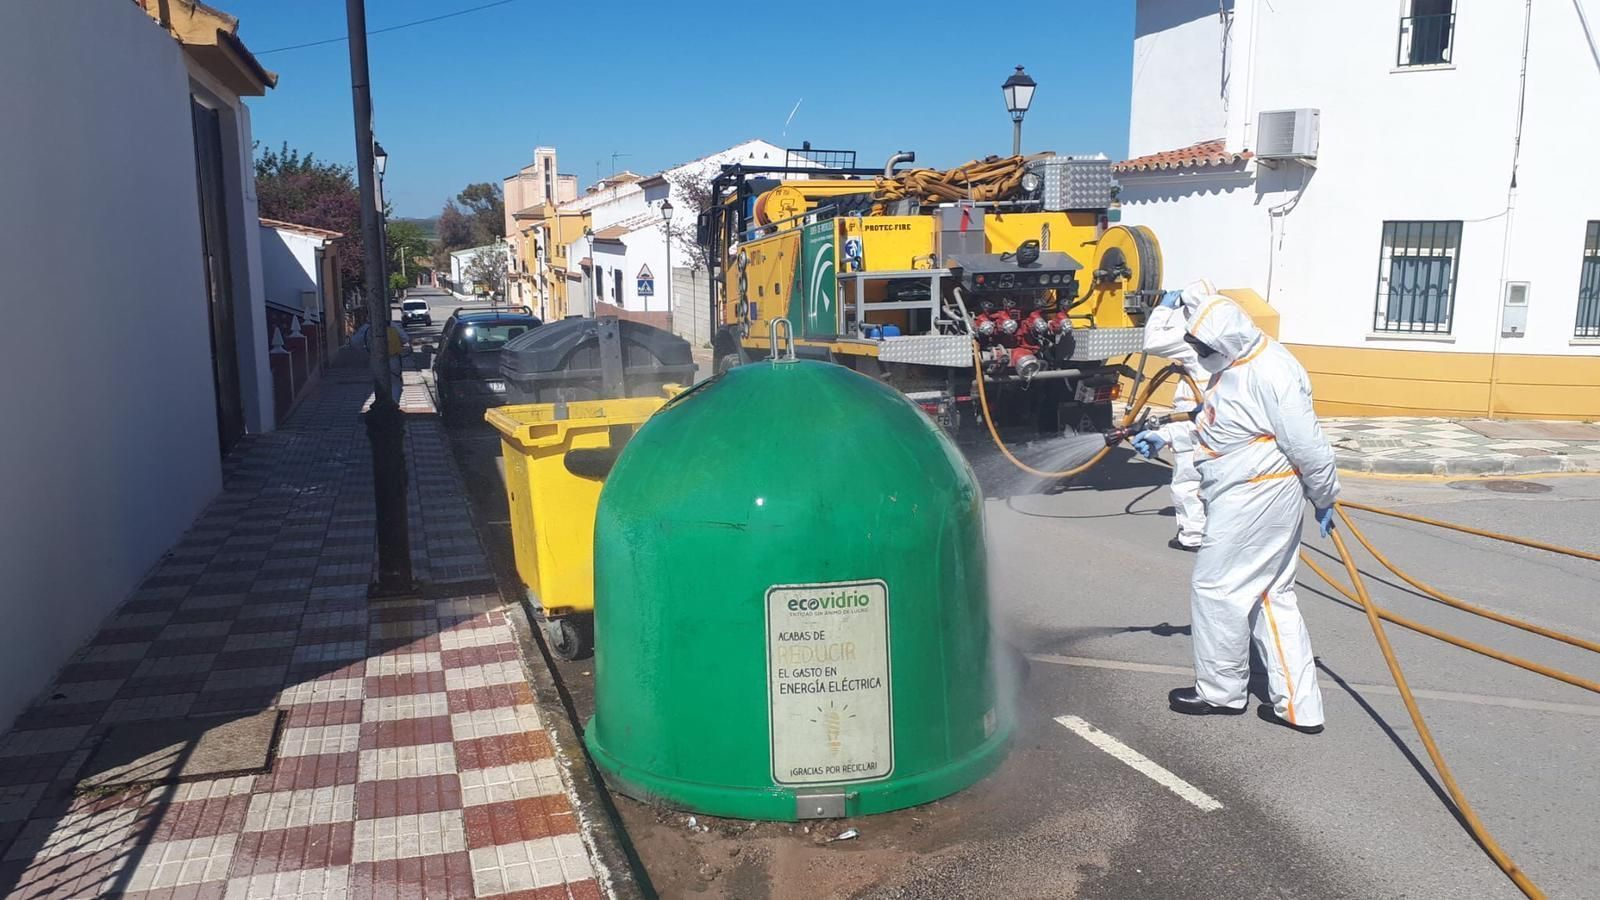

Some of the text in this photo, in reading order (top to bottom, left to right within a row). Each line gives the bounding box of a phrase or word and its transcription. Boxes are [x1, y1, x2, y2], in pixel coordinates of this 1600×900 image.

[864, 223, 912, 232] PROTEC-FIRE
[787, 591, 870, 611] ecovidrio
[778, 630, 825, 642] ACABAS DE
[778, 642, 856, 663] REDUCIR
[778, 666, 837, 679] EL GASTO EN
[779, 677, 882, 694] ENERGÍA ELÉCTRICA
[789, 761, 878, 777] ¡GRACIAS POR RECICLAR!
